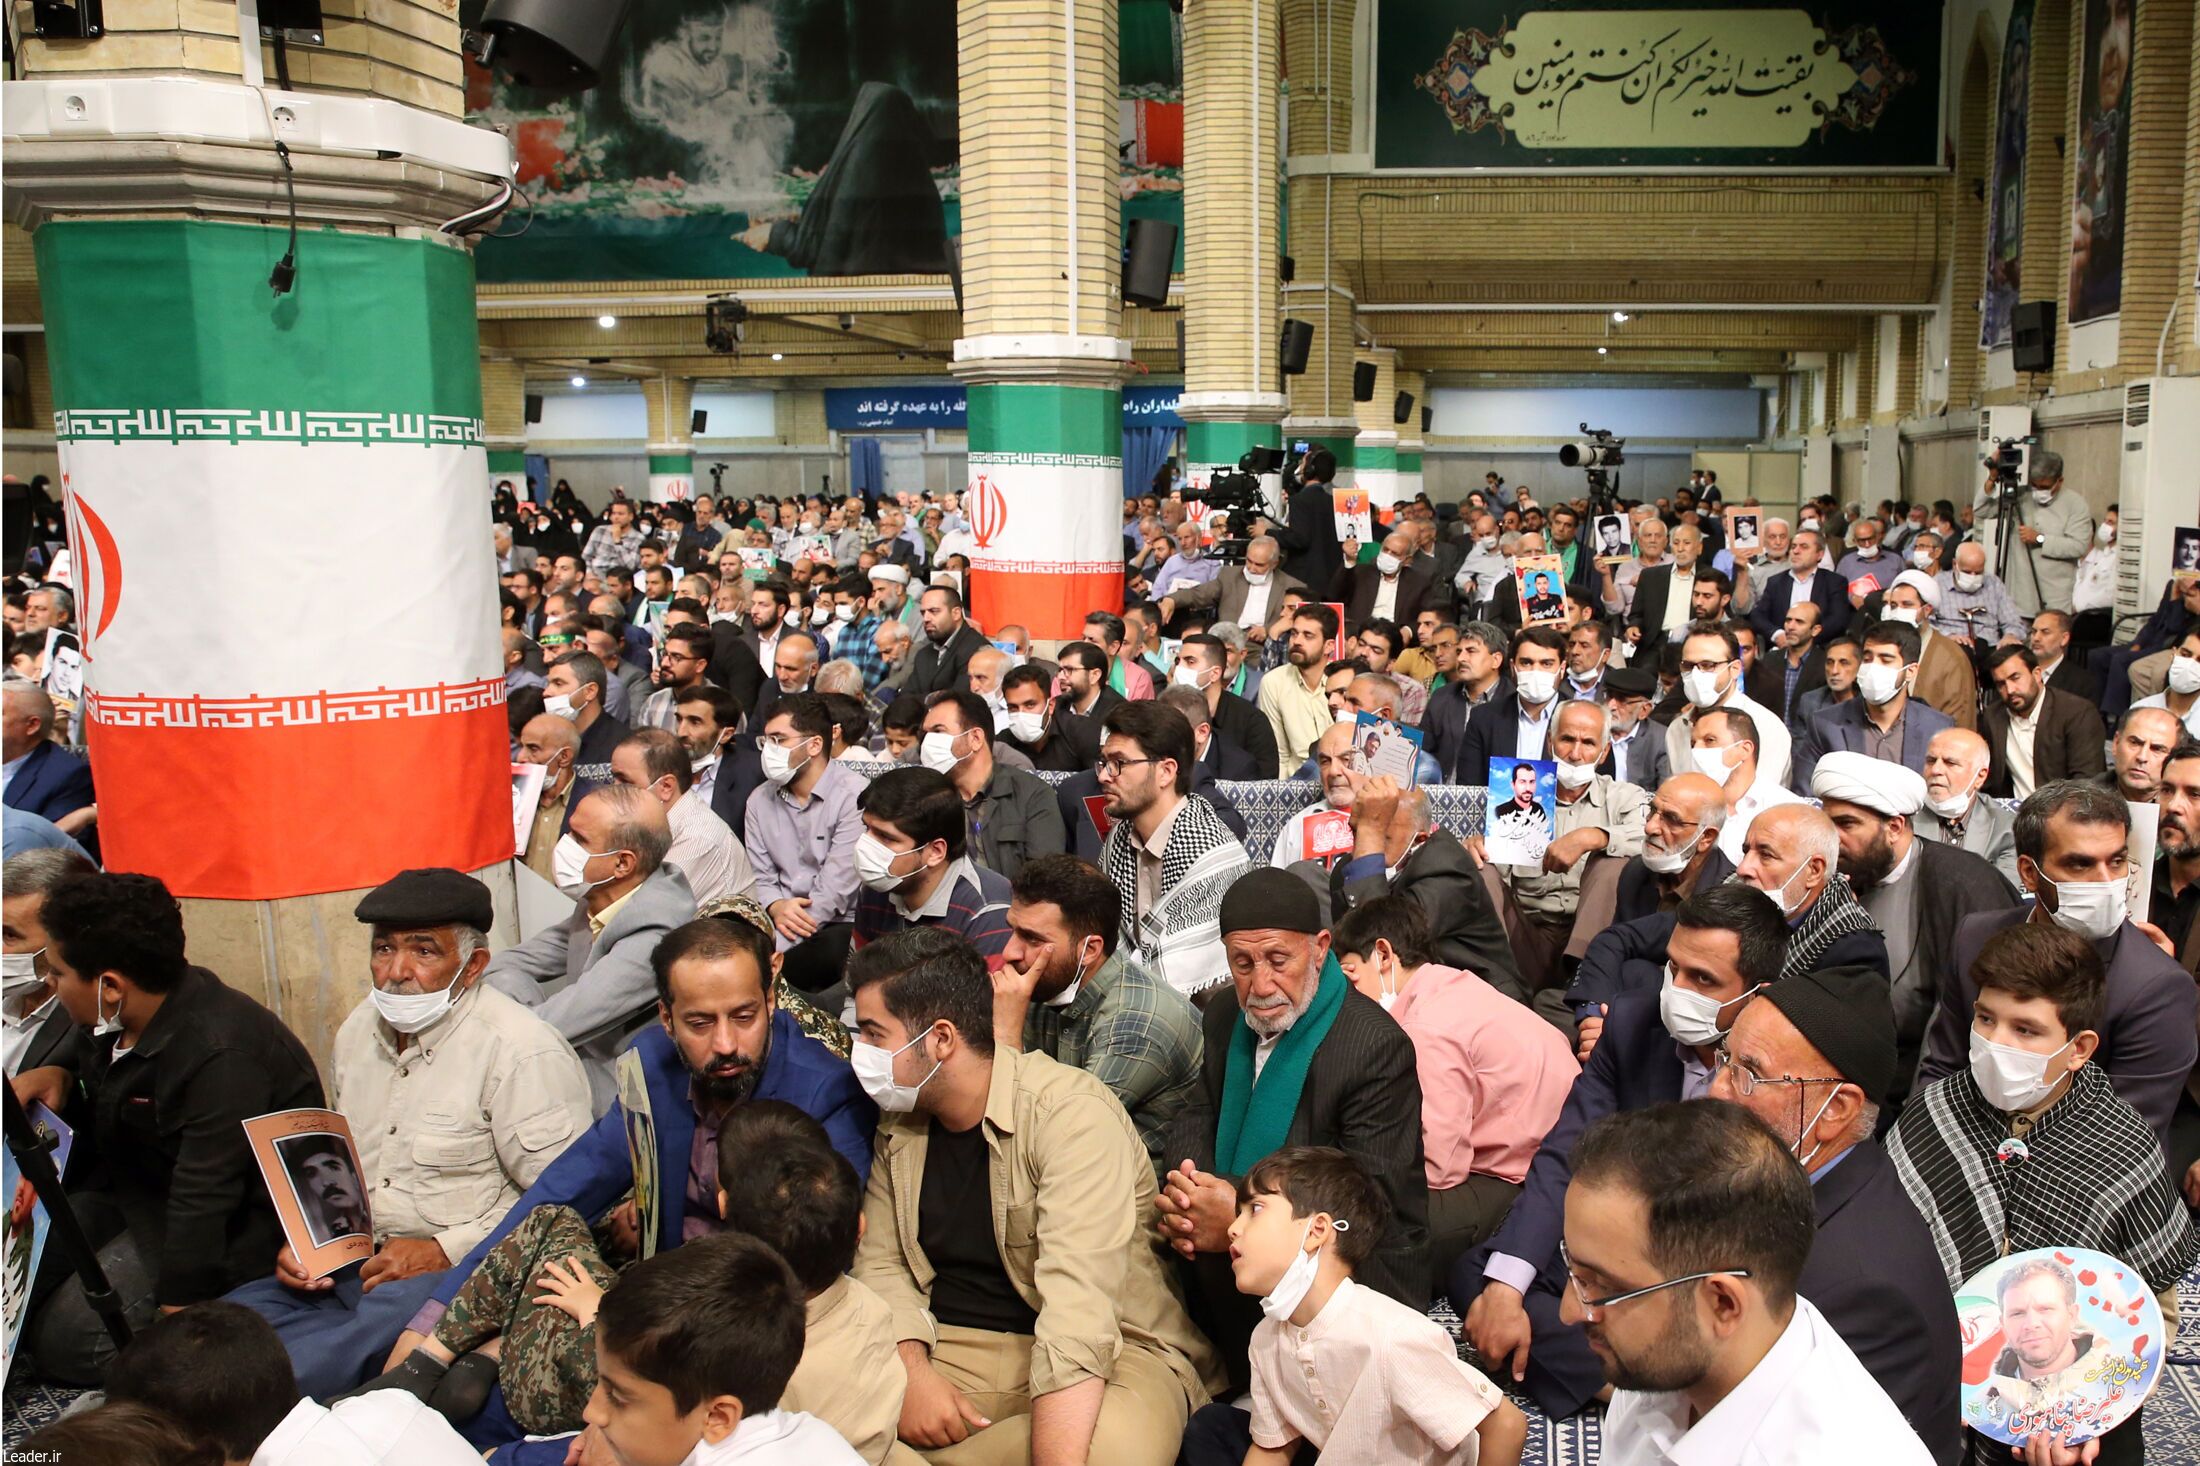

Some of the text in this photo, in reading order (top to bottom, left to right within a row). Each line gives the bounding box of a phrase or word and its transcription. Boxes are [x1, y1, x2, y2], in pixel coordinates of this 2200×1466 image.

[857, 401, 872, 414] اند
[902, 402, 927, 415] عهده
[940, 400, 951, 415] را
[1123, 400, 1139, 415] راه
